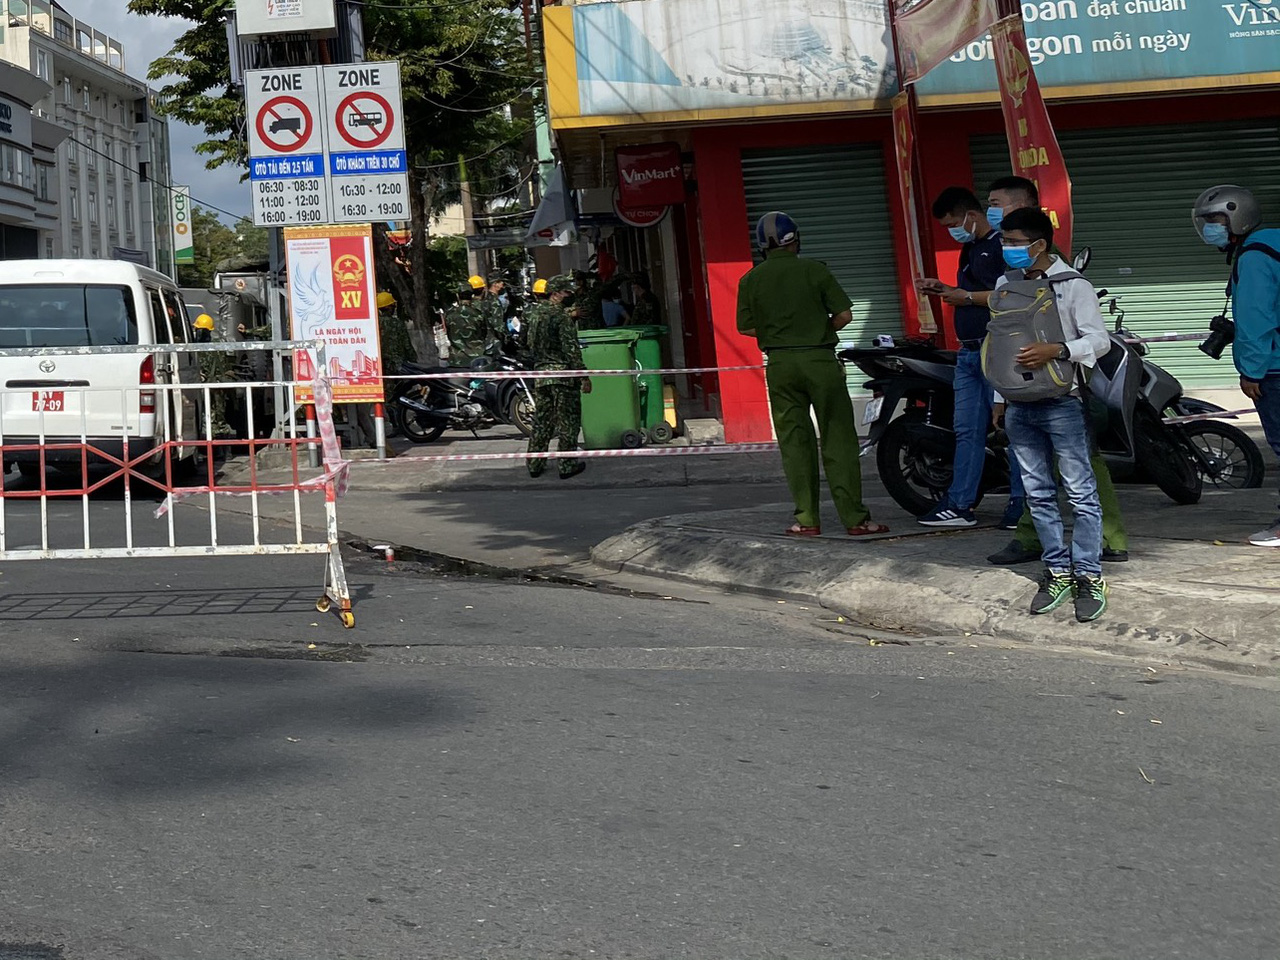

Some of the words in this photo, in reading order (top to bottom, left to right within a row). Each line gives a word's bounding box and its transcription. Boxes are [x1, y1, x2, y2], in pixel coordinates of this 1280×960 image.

[1027, 34, 1082, 66] gon
[1092, 32, 1132, 52] mỗi
[1139, 30, 1192, 52] ngày
[261, 74, 302, 92] ZONE
[338, 69, 380, 87] ZONE
[255, 161, 266, 175] ÔTÔ
[268, 159, 278, 175] TẢI
[279, 158, 291, 174] ĐẾN
[292, 161, 300, 175] 2,5
[302, 157, 314, 173] TẤN
[336, 156, 346, 170] ÔTÔ
[348, 155, 365, 170] KHÁCH
[366, 154, 380, 169] TRÊN
[381, 157, 388, 168] 30
[259, 181, 284, 193] 06:30
[294, 180, 318, 191] 08:30
[376, 183, 401, 194] 12:00
[175, 194, 186, 222] OCB
[260, 196, 284, 208] 11:00
[295, 195, 319, 206] 12:00
[262, 211, 285, 222] 16:00
[296, 209, 320, 221] 19:00
[341, 204, 366, 216] 16:30
[378, 203, 403, 214] 19:00
[340, 290, 362, 308] XV
[315, 328, 324, 336] LÀ
[326, 327, 346, 335] NGÀY
[348, 327, 361, 335] HỘI
[329, 336, 348, 344] TOÀN
[350, 336, 366, 344] DÂN
